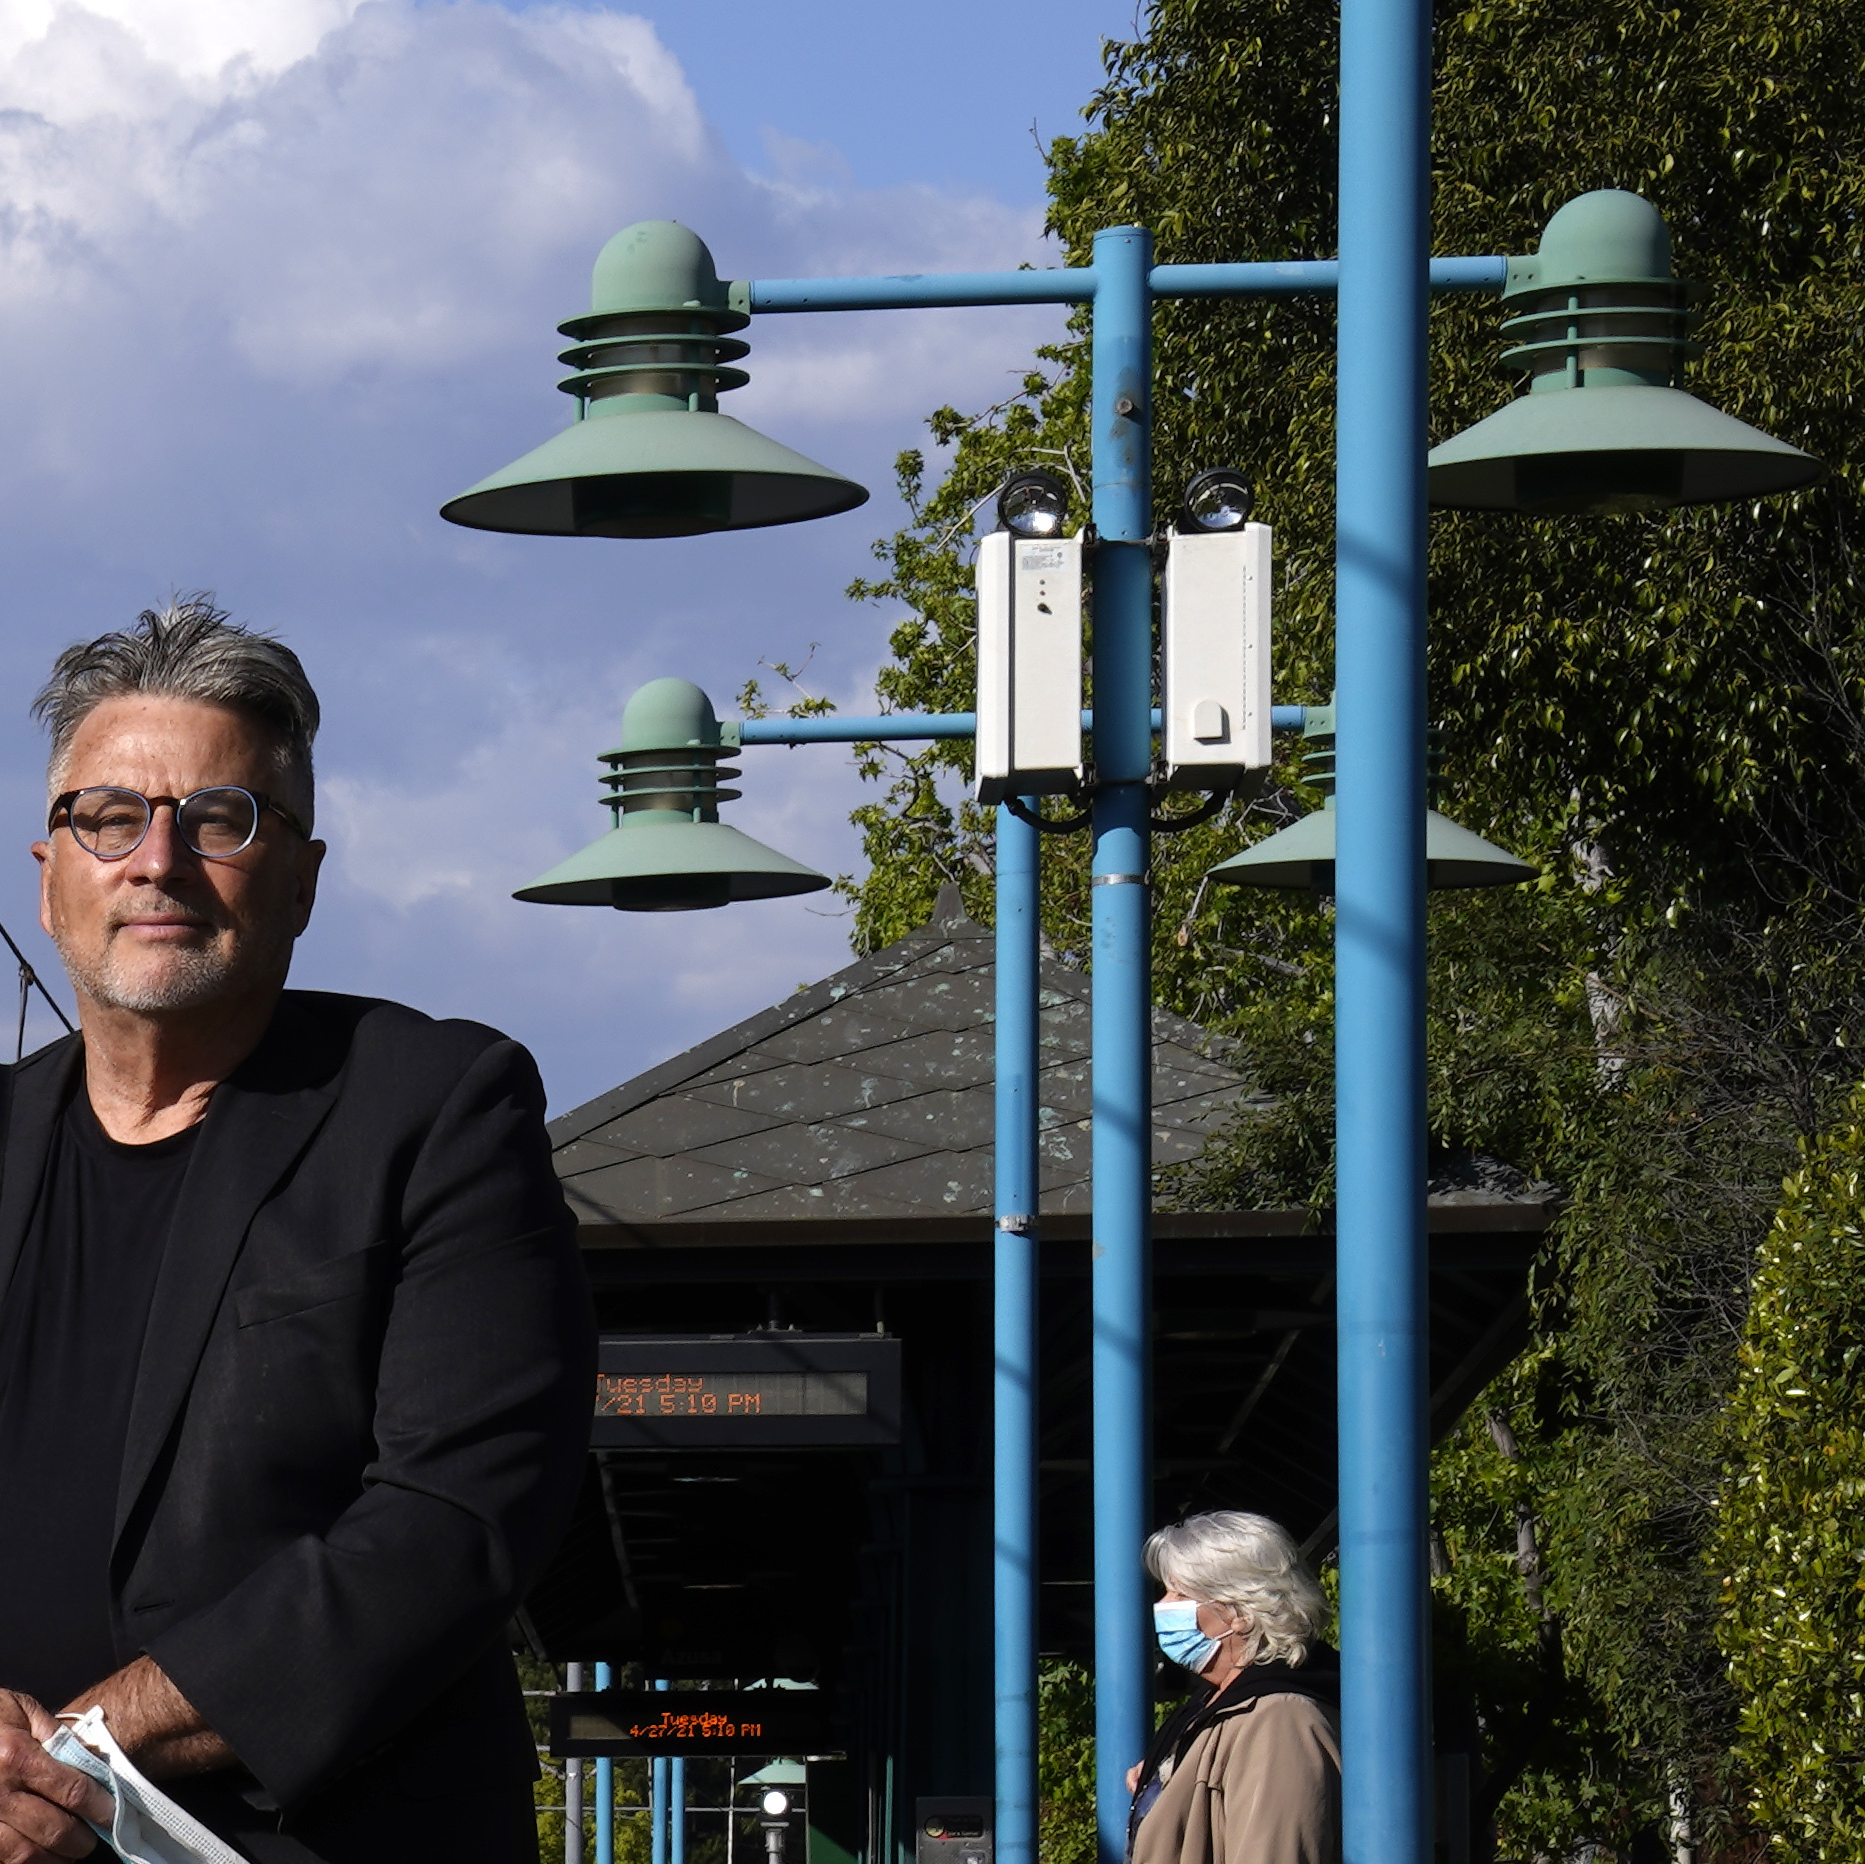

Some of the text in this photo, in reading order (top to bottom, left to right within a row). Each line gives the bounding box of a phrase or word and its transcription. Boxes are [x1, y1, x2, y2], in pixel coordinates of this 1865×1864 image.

[596, 1372, 704, 1394] Tuesday
[596, 1393, 762, 1415] /21 5:10 PM
[660, 1711, 728, 1725] Tuesday
[629, 1723, 762, 1738] 4/27/21 5:10 PM
